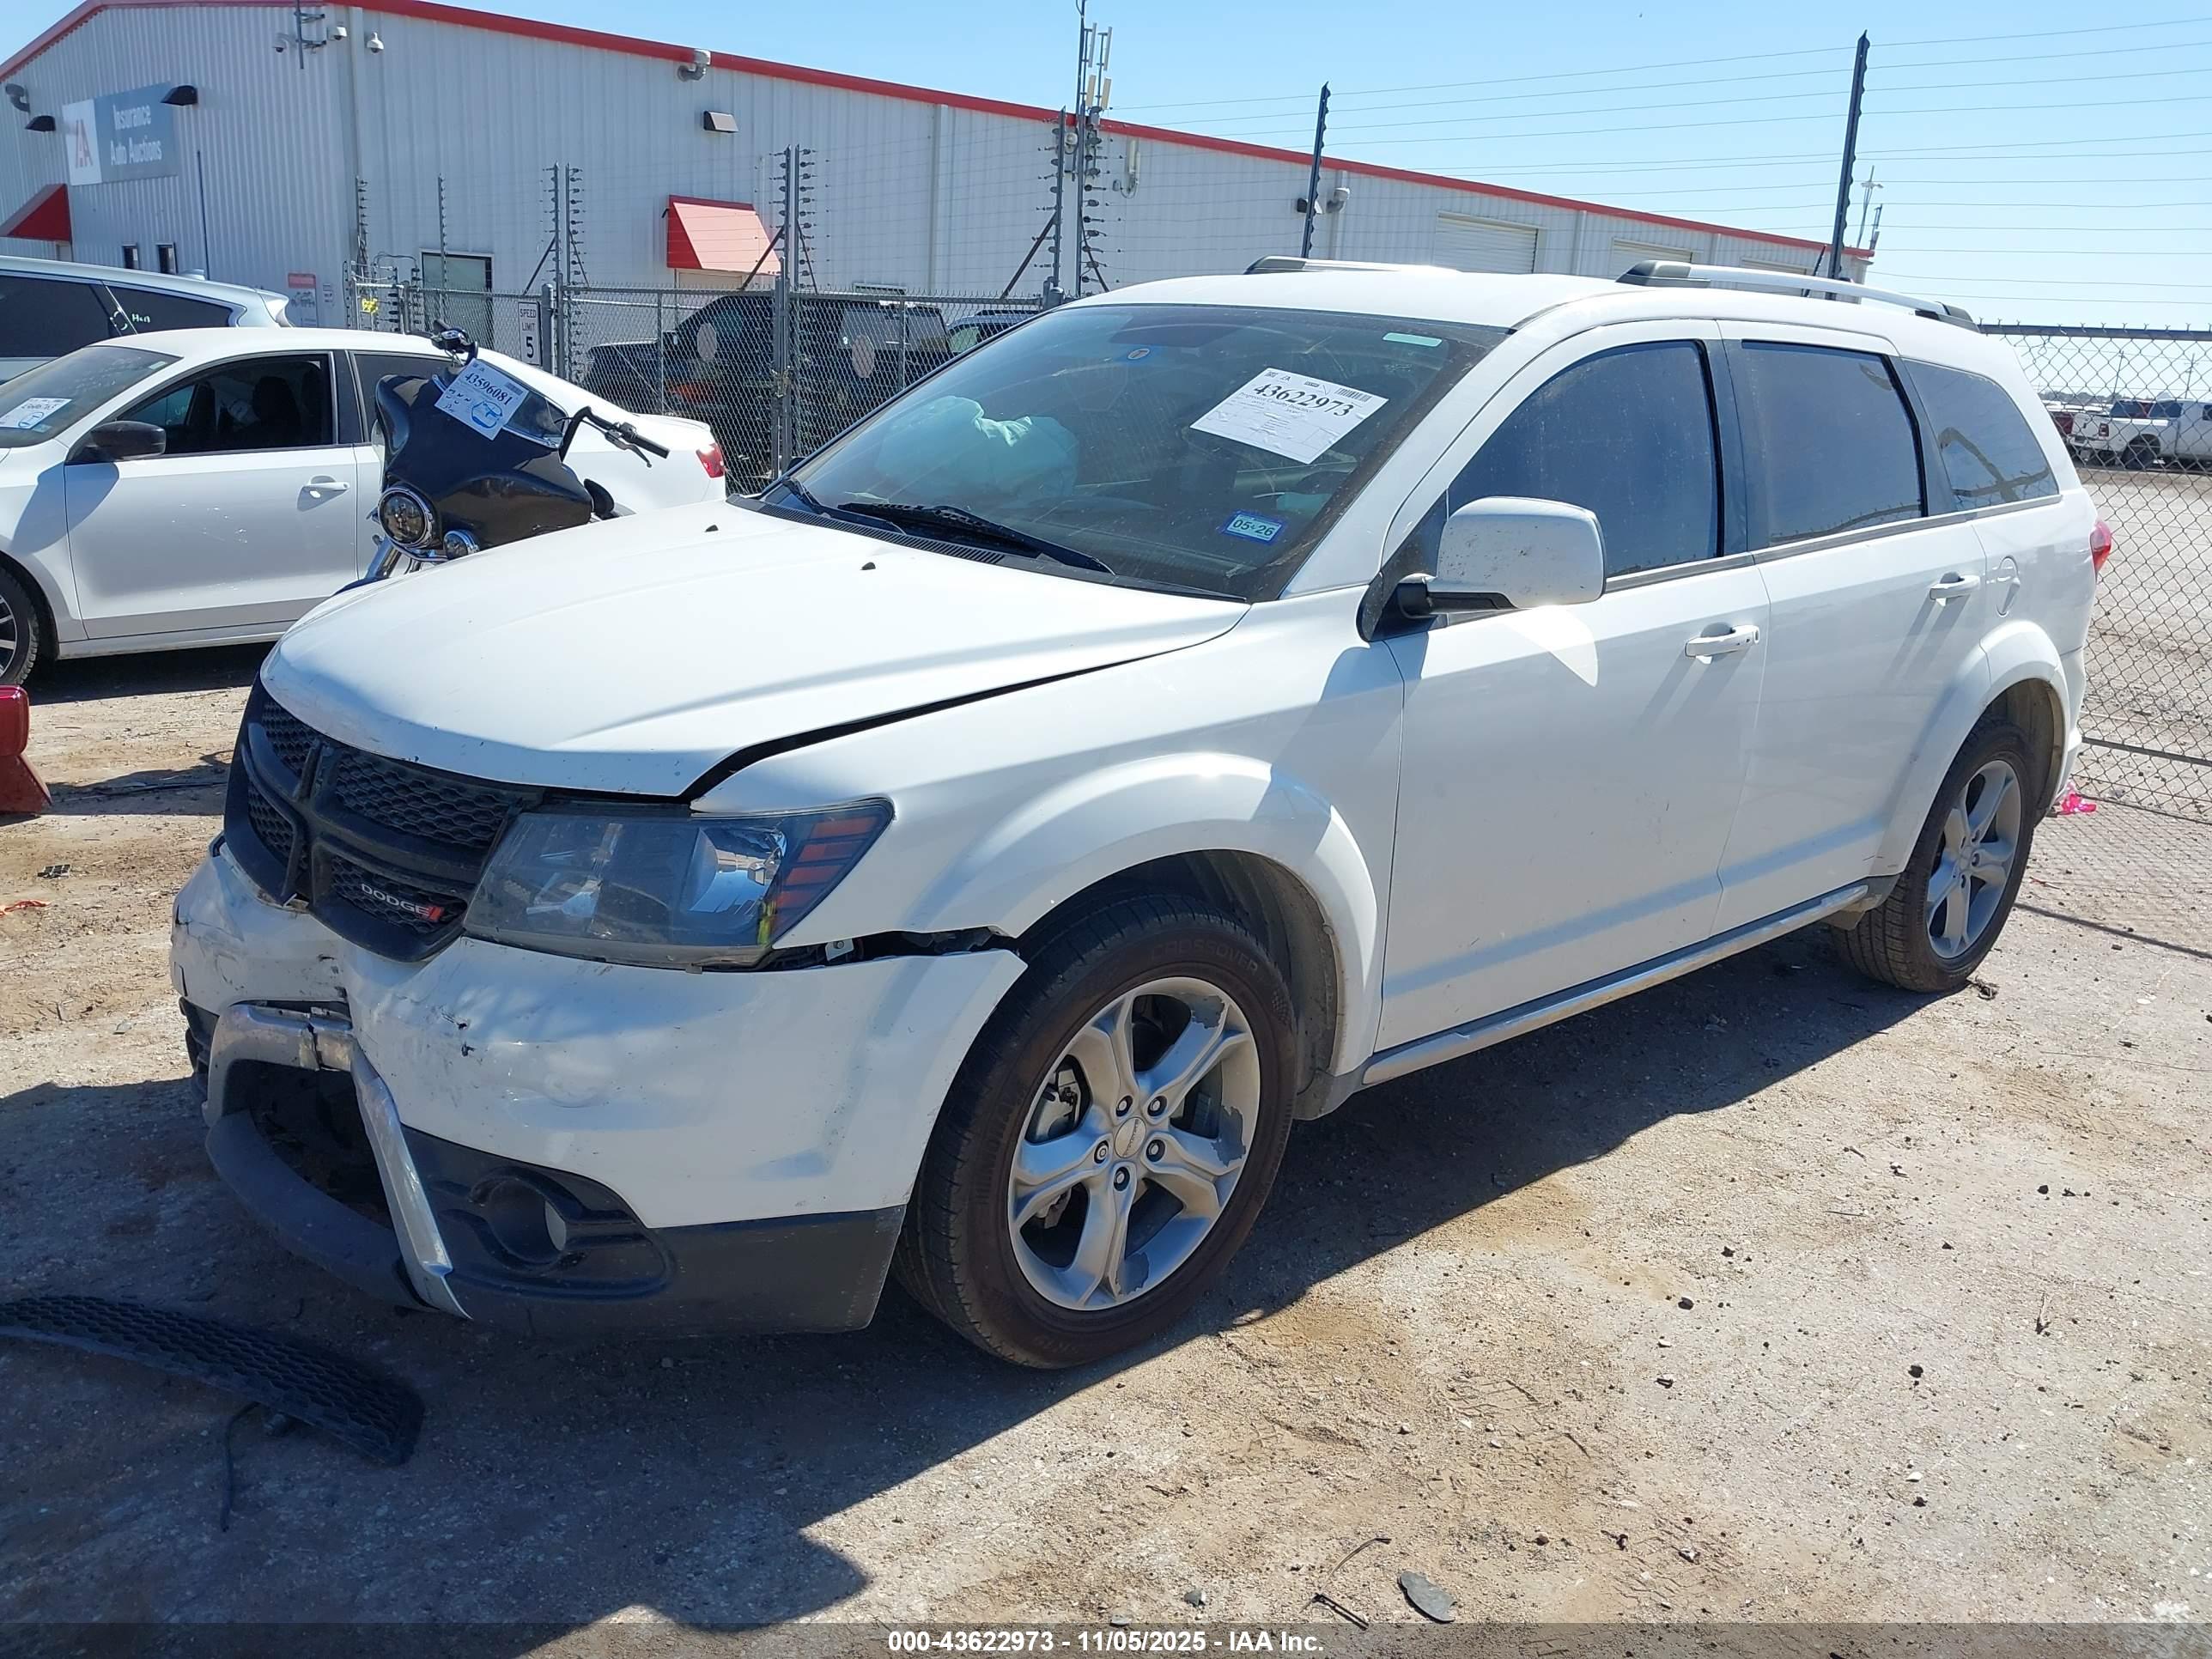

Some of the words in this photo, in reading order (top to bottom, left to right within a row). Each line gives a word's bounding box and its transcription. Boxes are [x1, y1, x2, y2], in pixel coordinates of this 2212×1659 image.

[112, 103, 152, 131] Insurance
[110, 139, 128, 166] Auto
[128, 134, 163, 164] Auctions
[520, 308, 537, 319] SPEED
[521, 322, 536, 332] LIMIT
[526, 336, 534, 359] 5
[465, 372, 514, 406] 43596081
[1253, 383, 1355, 416] 43622973
[1231, 519, 1253, 531] 05
[1254, 524, 1276, 537] 26
[361, 883, 431, 917] DODGE
